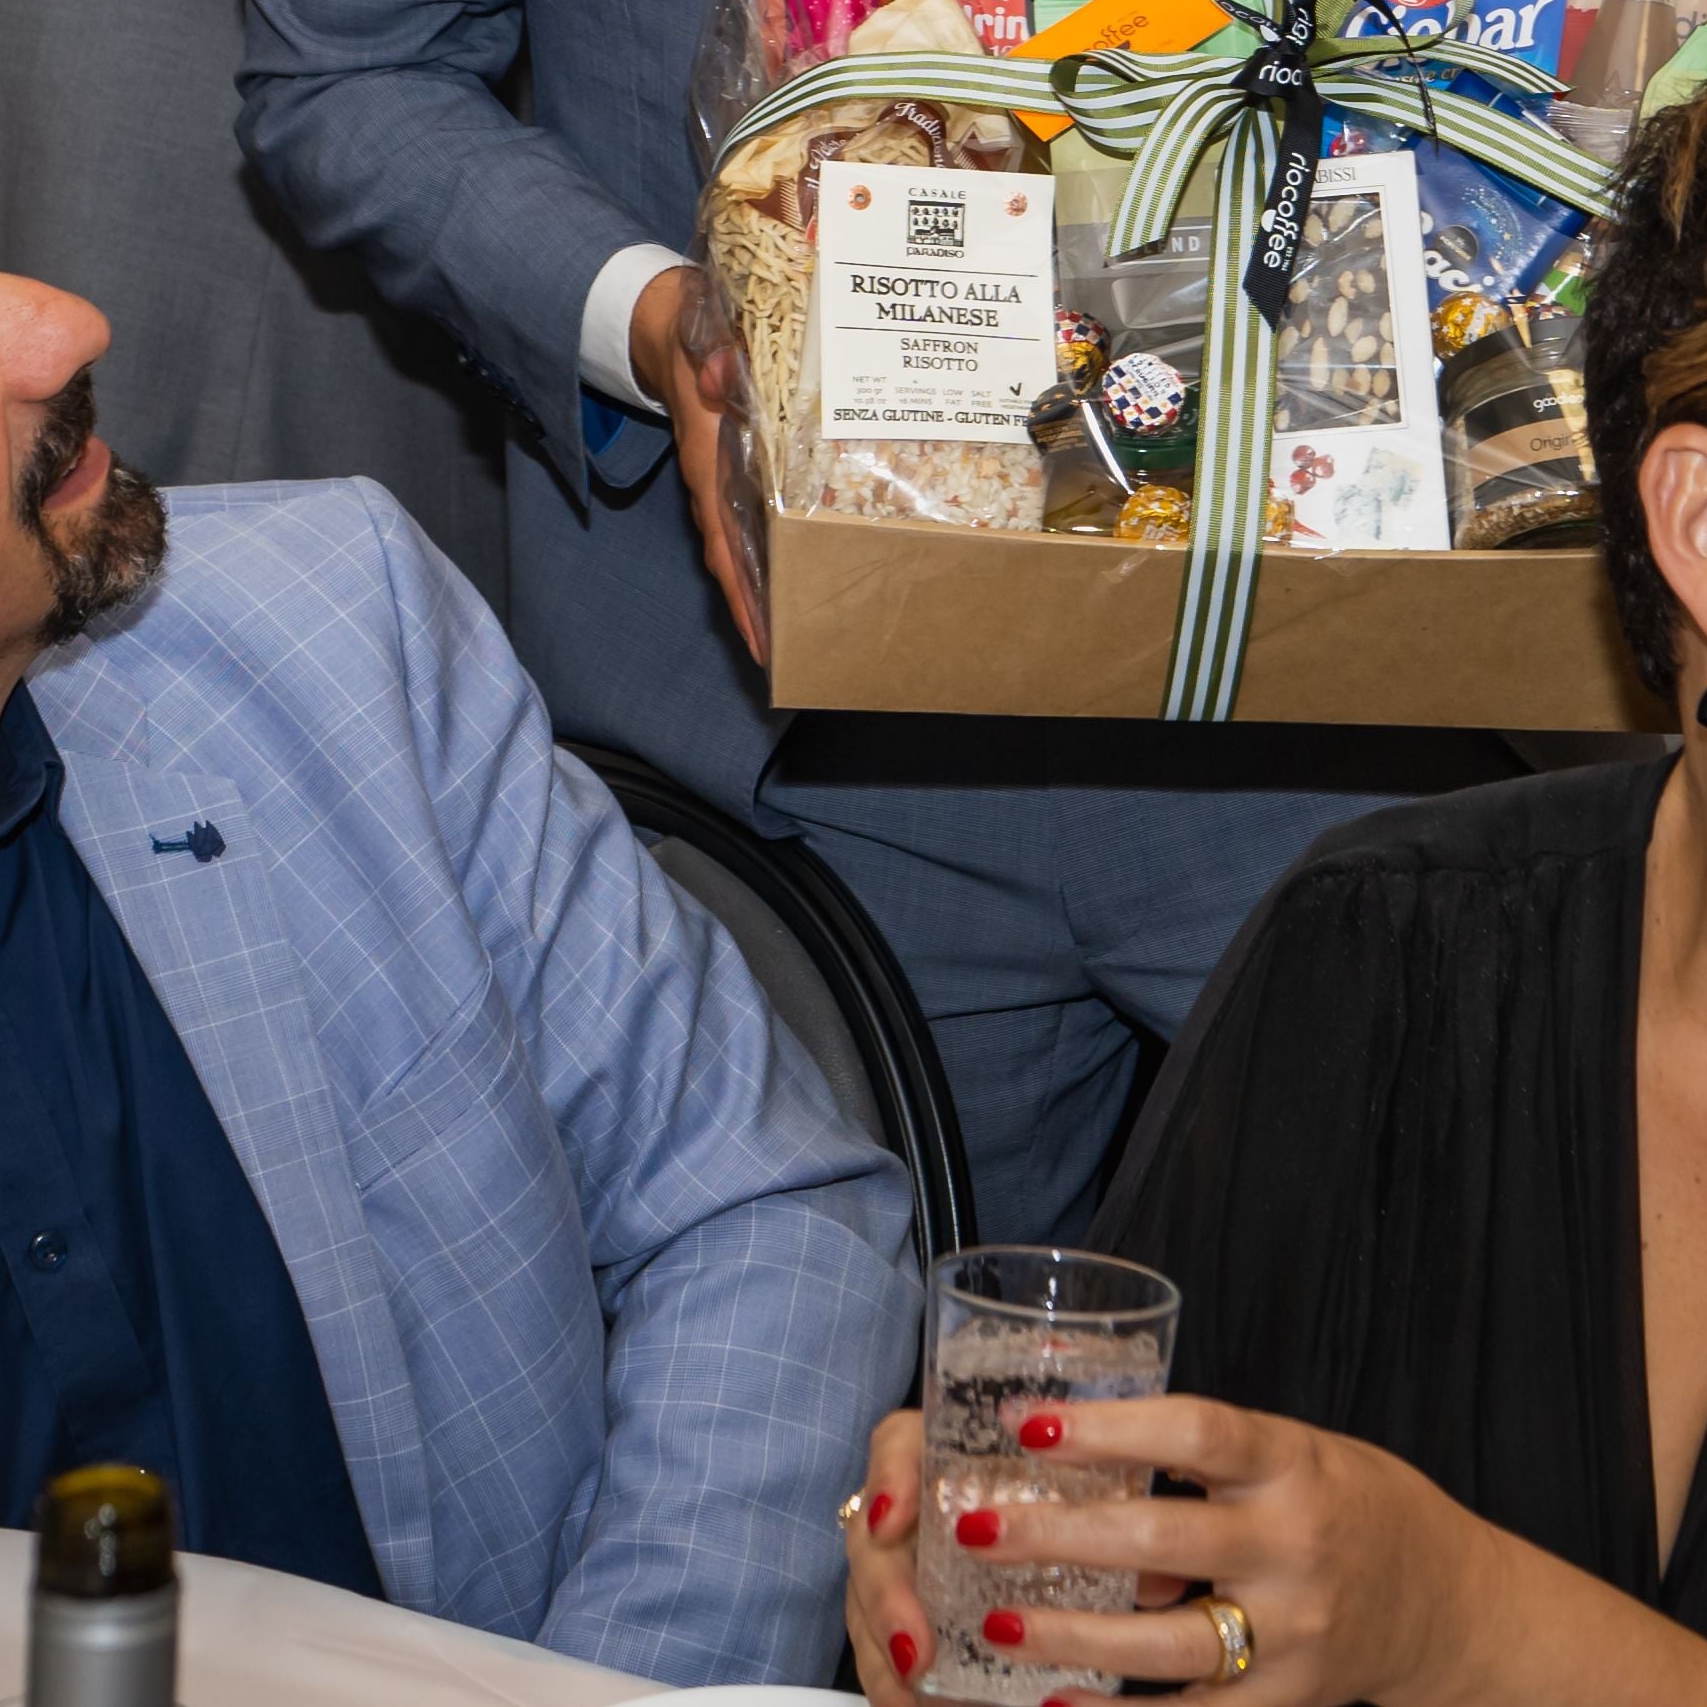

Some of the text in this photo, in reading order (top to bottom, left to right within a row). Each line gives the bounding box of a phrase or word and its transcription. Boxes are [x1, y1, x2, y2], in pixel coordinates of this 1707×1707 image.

[1083, 16, 1149, 50] offee
[908, 188, 967, 199] CASALE
[1263, 152, 1311, 268] riocoffee
[906, 246, 965, 259] PARADISO
[850, 274, 1022, 303] RISOTTO ALLA
[876, 302, 1000, 328] MILANESE
[900, 338, 978, 354] SAFFRON
[903, 355, 978, 372] RISOTTO
[895, 386, 936, 395] SERVINGS
[942, 388, 963, 396] LOW
[971, 390, 992, 398] SALT
[945, 398, 962, 406] FAT
[971, 400, 992, 408] FREE
[833, 408, 879, 422] SENZA
[882, 409, 944, 423] GLUTINE
[955, 411, 1011, 426] GLUTEN
